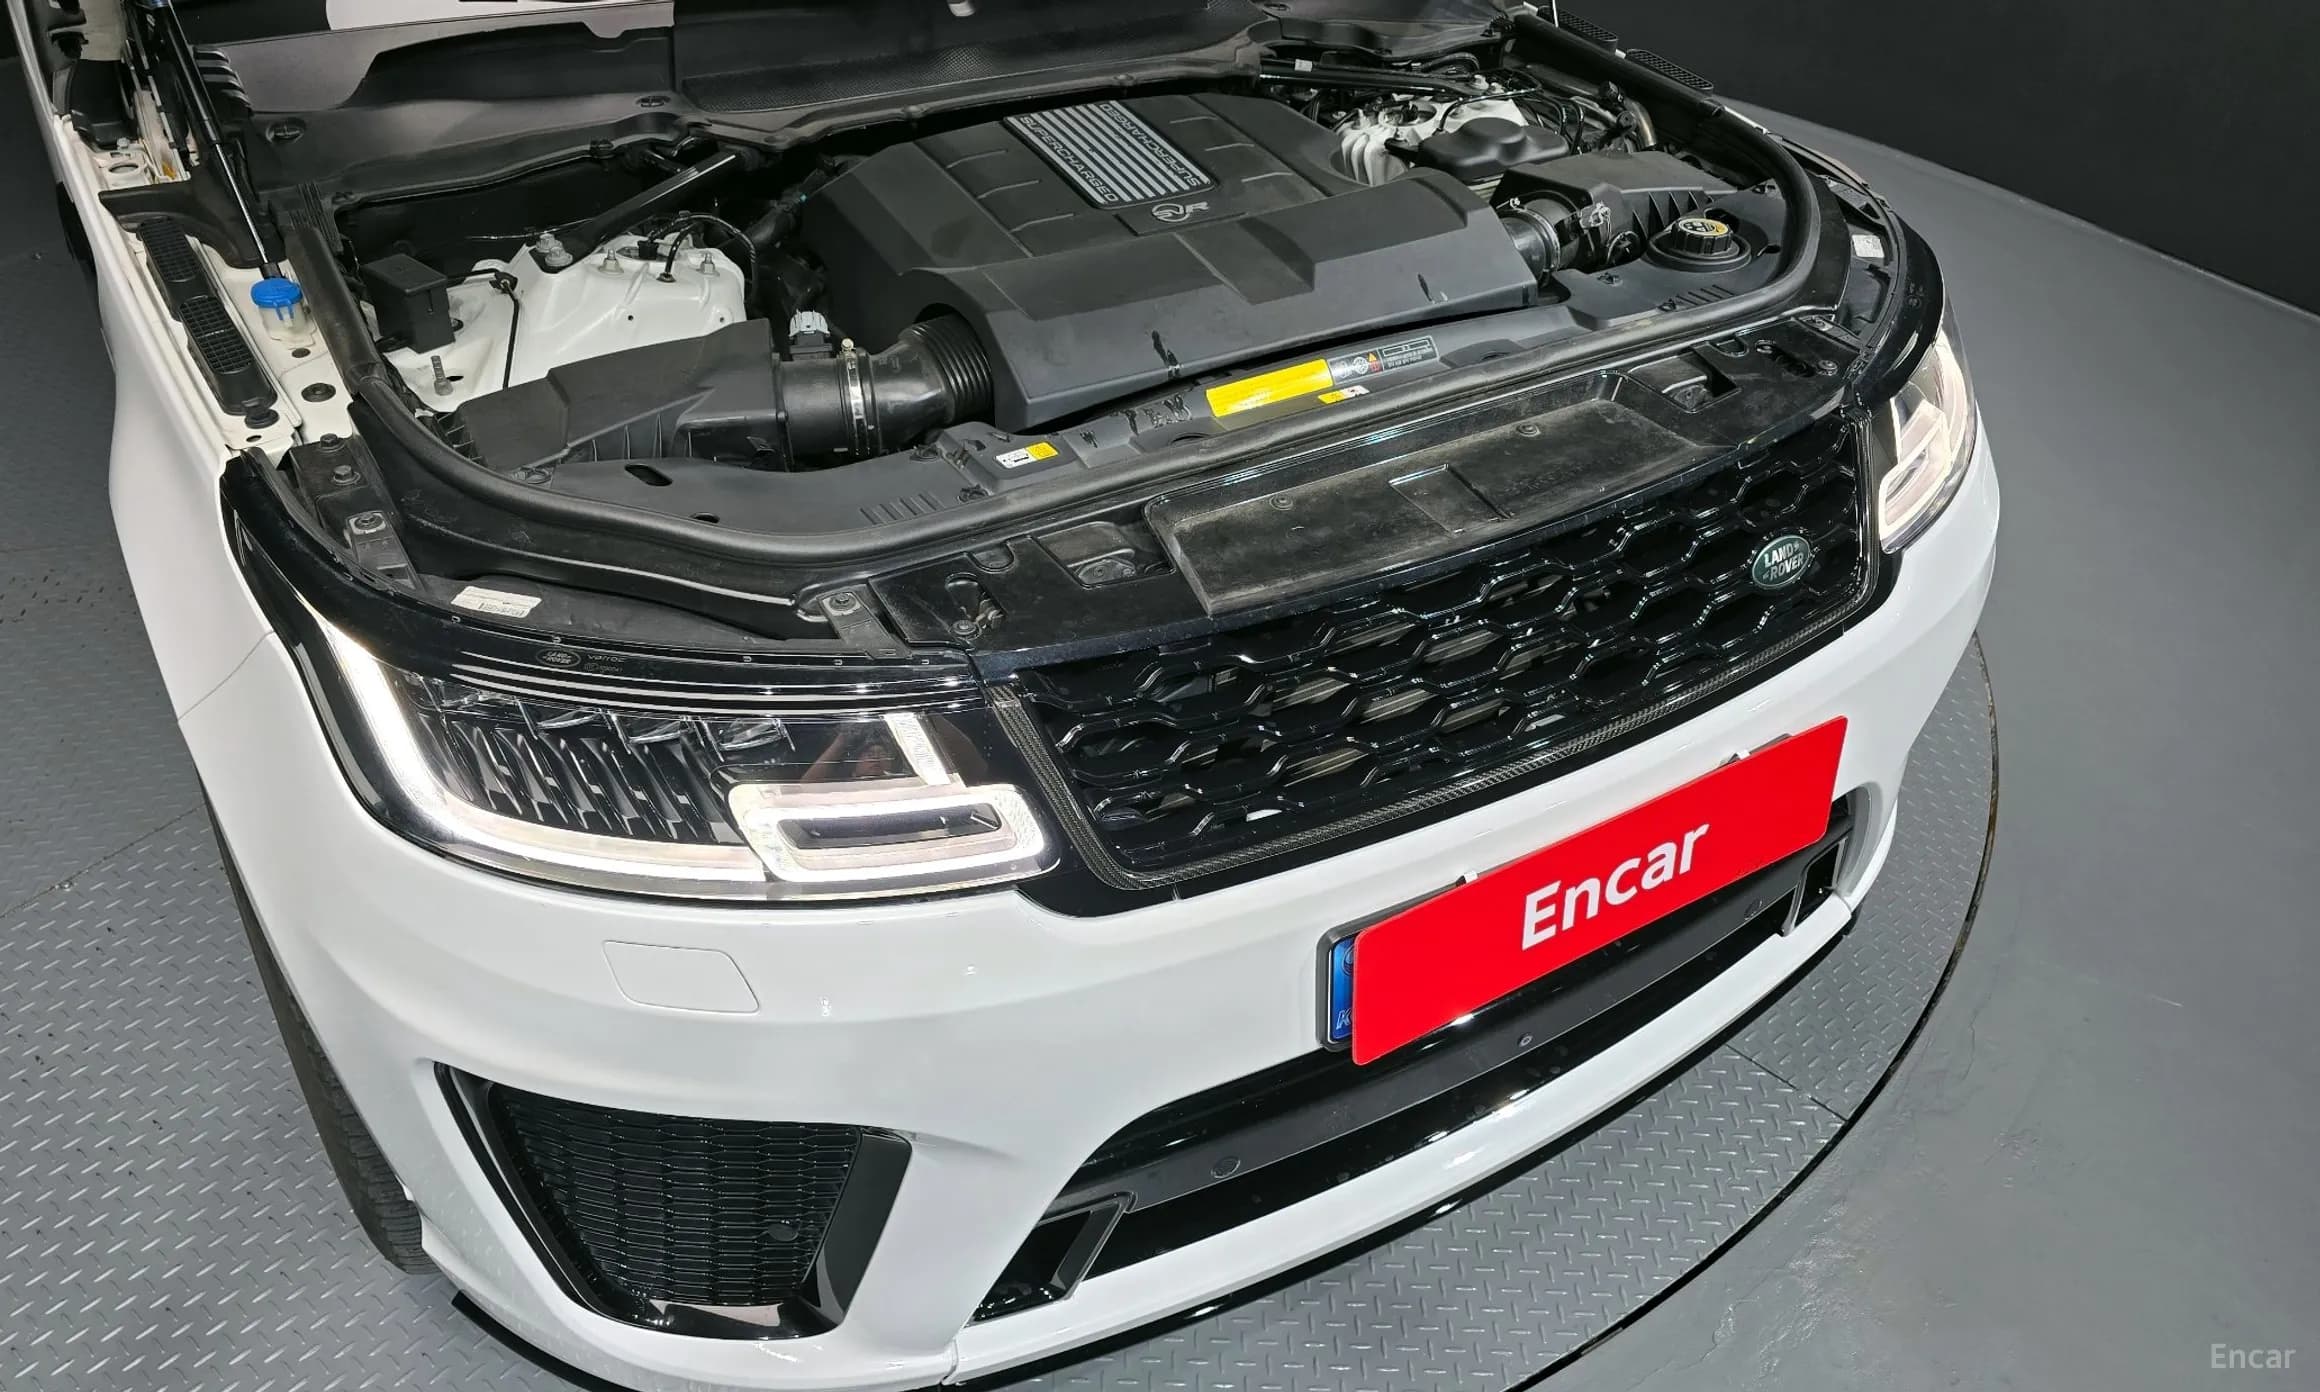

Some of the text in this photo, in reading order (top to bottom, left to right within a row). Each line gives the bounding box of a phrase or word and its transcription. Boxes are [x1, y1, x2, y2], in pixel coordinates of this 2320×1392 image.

[1020, 116, 1119, 202] SUPERCHARGED
[1101, 103, 1200, 187] SUPERCHARGED
[1763, 543, 1793, 568] LAND
[1770, 552, 1804, 581] ROVER
[1522, 823, 1710, 951] Encar
